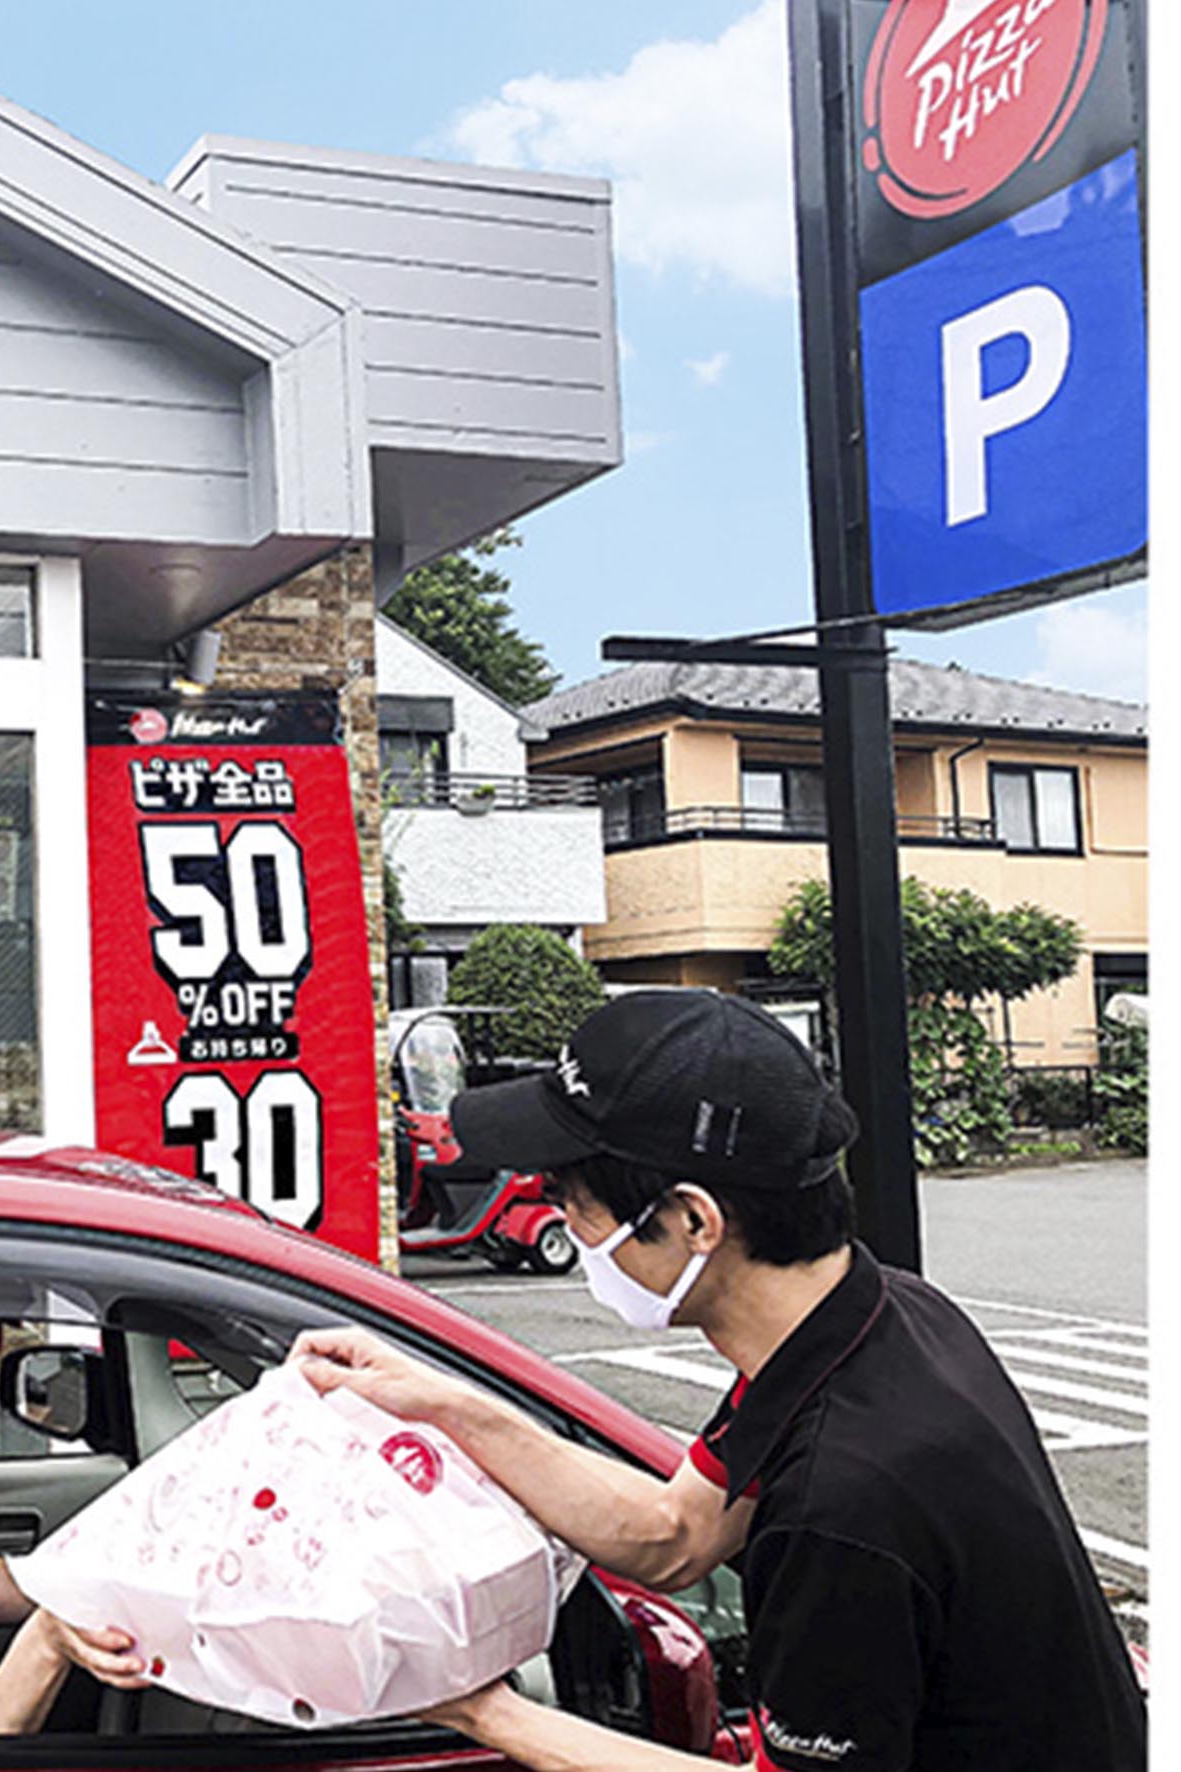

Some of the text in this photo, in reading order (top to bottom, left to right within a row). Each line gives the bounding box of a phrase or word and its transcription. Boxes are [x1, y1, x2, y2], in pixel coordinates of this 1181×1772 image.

[939, 37, 1042, 161] Hut
[941, 285, 1071, 528] P
[130, 756, 295, 809] ピザ全品
[139, 819, 309, 980] 50
[165, 1070, 321, 1230] 30
